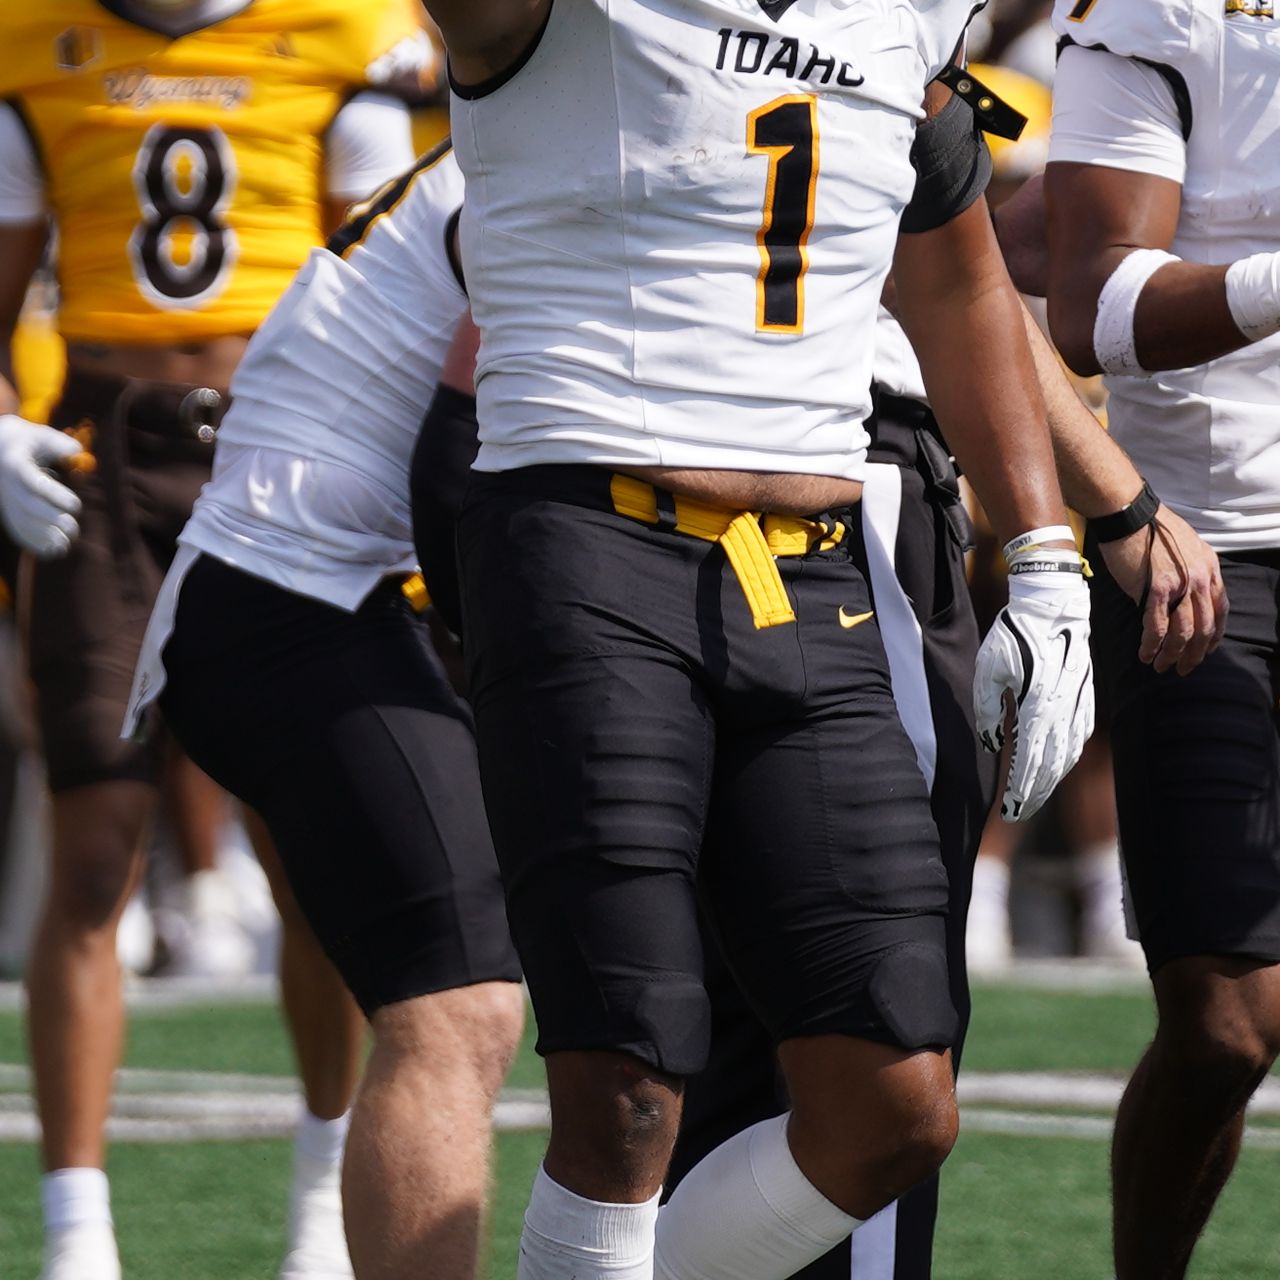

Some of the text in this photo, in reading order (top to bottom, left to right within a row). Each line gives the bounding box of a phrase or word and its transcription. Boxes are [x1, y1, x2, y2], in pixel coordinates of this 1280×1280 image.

[715, 27, 866, 88] IDAHO
[128, 119, 239, 312] 8
[745, 92, 820, 336] 1
